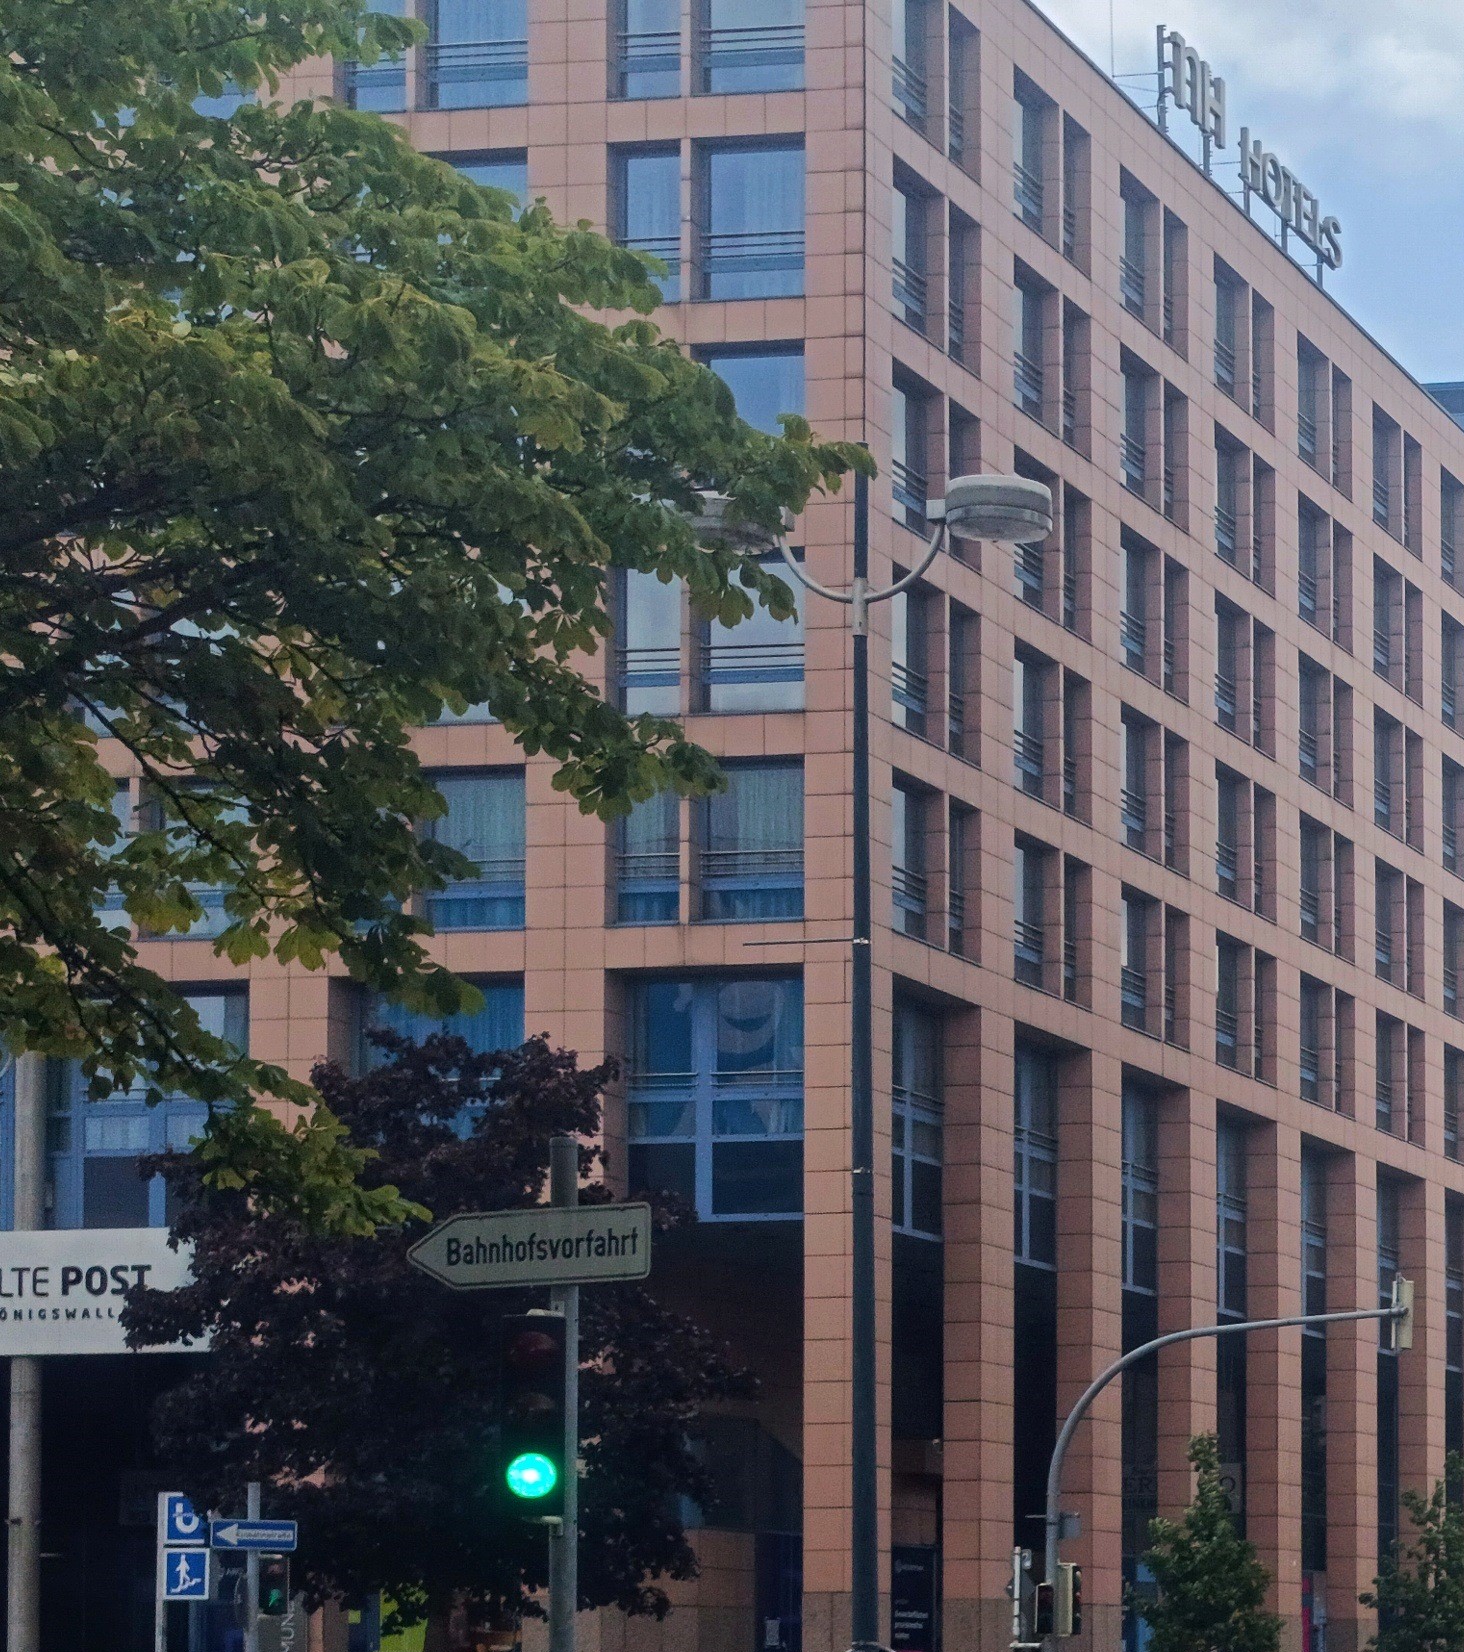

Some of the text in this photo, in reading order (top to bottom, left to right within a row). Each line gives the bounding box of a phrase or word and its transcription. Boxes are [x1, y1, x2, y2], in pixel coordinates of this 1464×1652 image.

[1238, 126, 1344, 271] HOTELS
[445, 1226, 639, 1267] Bahnhofsvorfahrt
[61, 1264, 152, 1297] POST
